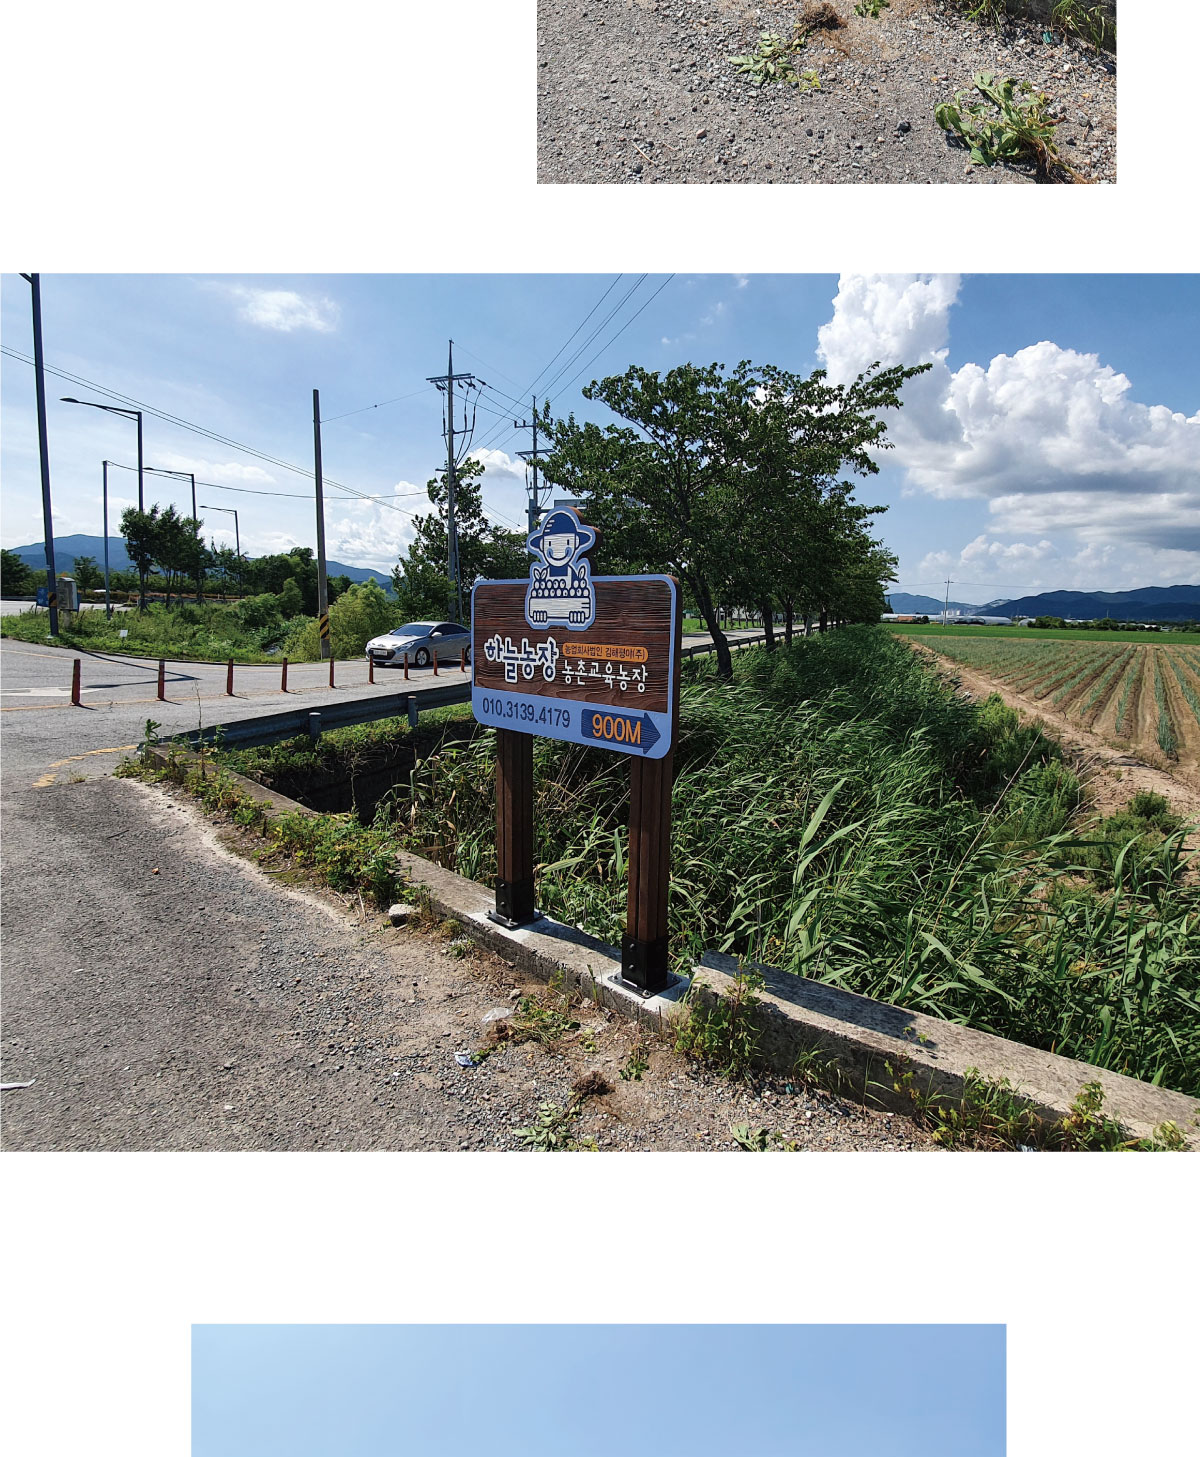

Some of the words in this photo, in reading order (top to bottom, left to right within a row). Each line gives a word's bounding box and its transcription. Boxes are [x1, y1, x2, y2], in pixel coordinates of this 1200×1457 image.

[484, 634, 560, 684] 하늘농장
[562, 660, 648, 693] 농촌교육농장
[482, 697, 571, 728] 010.3139.4179
[592, 713, 641, 745] 900M
